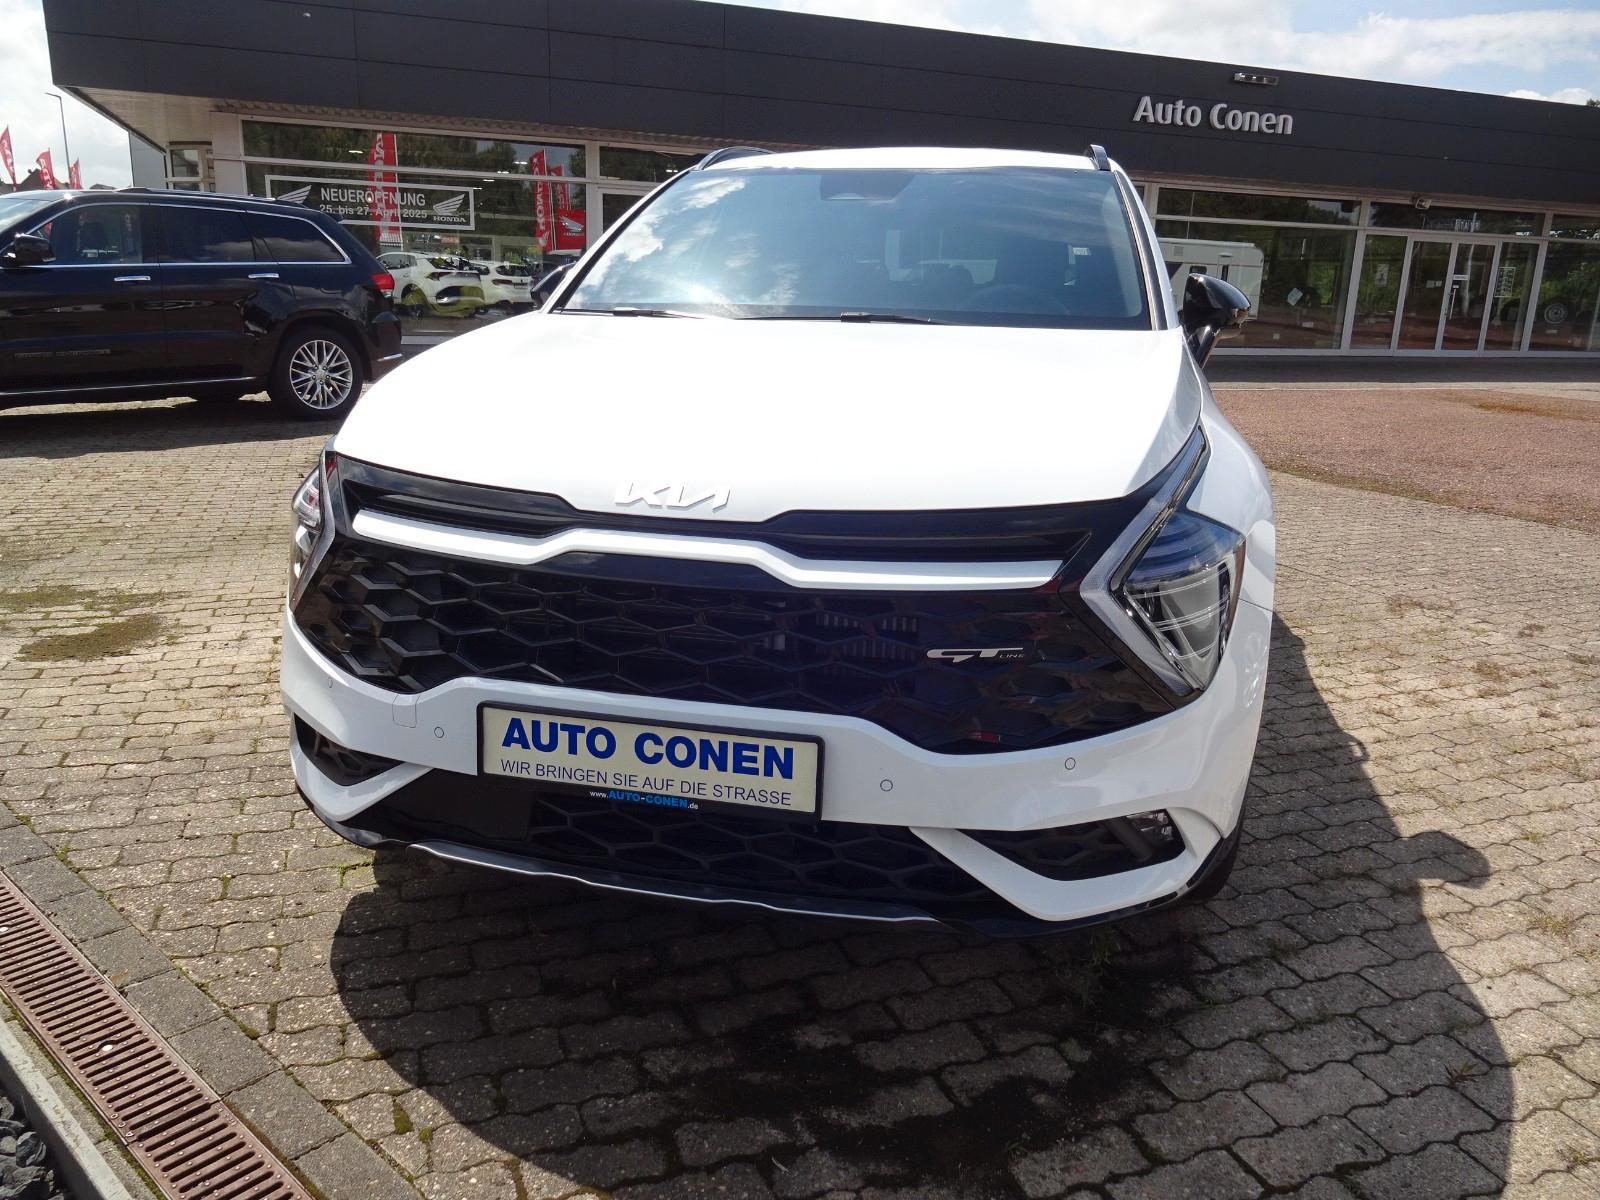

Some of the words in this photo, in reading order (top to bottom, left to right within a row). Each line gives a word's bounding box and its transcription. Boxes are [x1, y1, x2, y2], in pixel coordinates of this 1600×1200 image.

[1132, 95, 1202, 127] Auto
[1209, 102, 1294, 135] Conen
[320, 187, 426, 206] NEUERÖFFNUNG
[338, 205, 354, 215] bis
[375, 207, 399, 218] April
[402, 208, 428, 219] 2025
[433, 215, 467, 223] HONDA
[501, 717, 617, 760] AUTO
[633, 731, 794, 780] CONEN
[500, 759, 531, 776] WIR
[535, 763, 608, 785] BRINGEN
[612, 772, 639, 788] SIE
[642, 776, 675, 792] AUF
[679, 780, 707, 796] DIE
[712, 784, 792, 807] STRASSE
[589, 790, 699, 810] www.AUTO-CONEN.de
